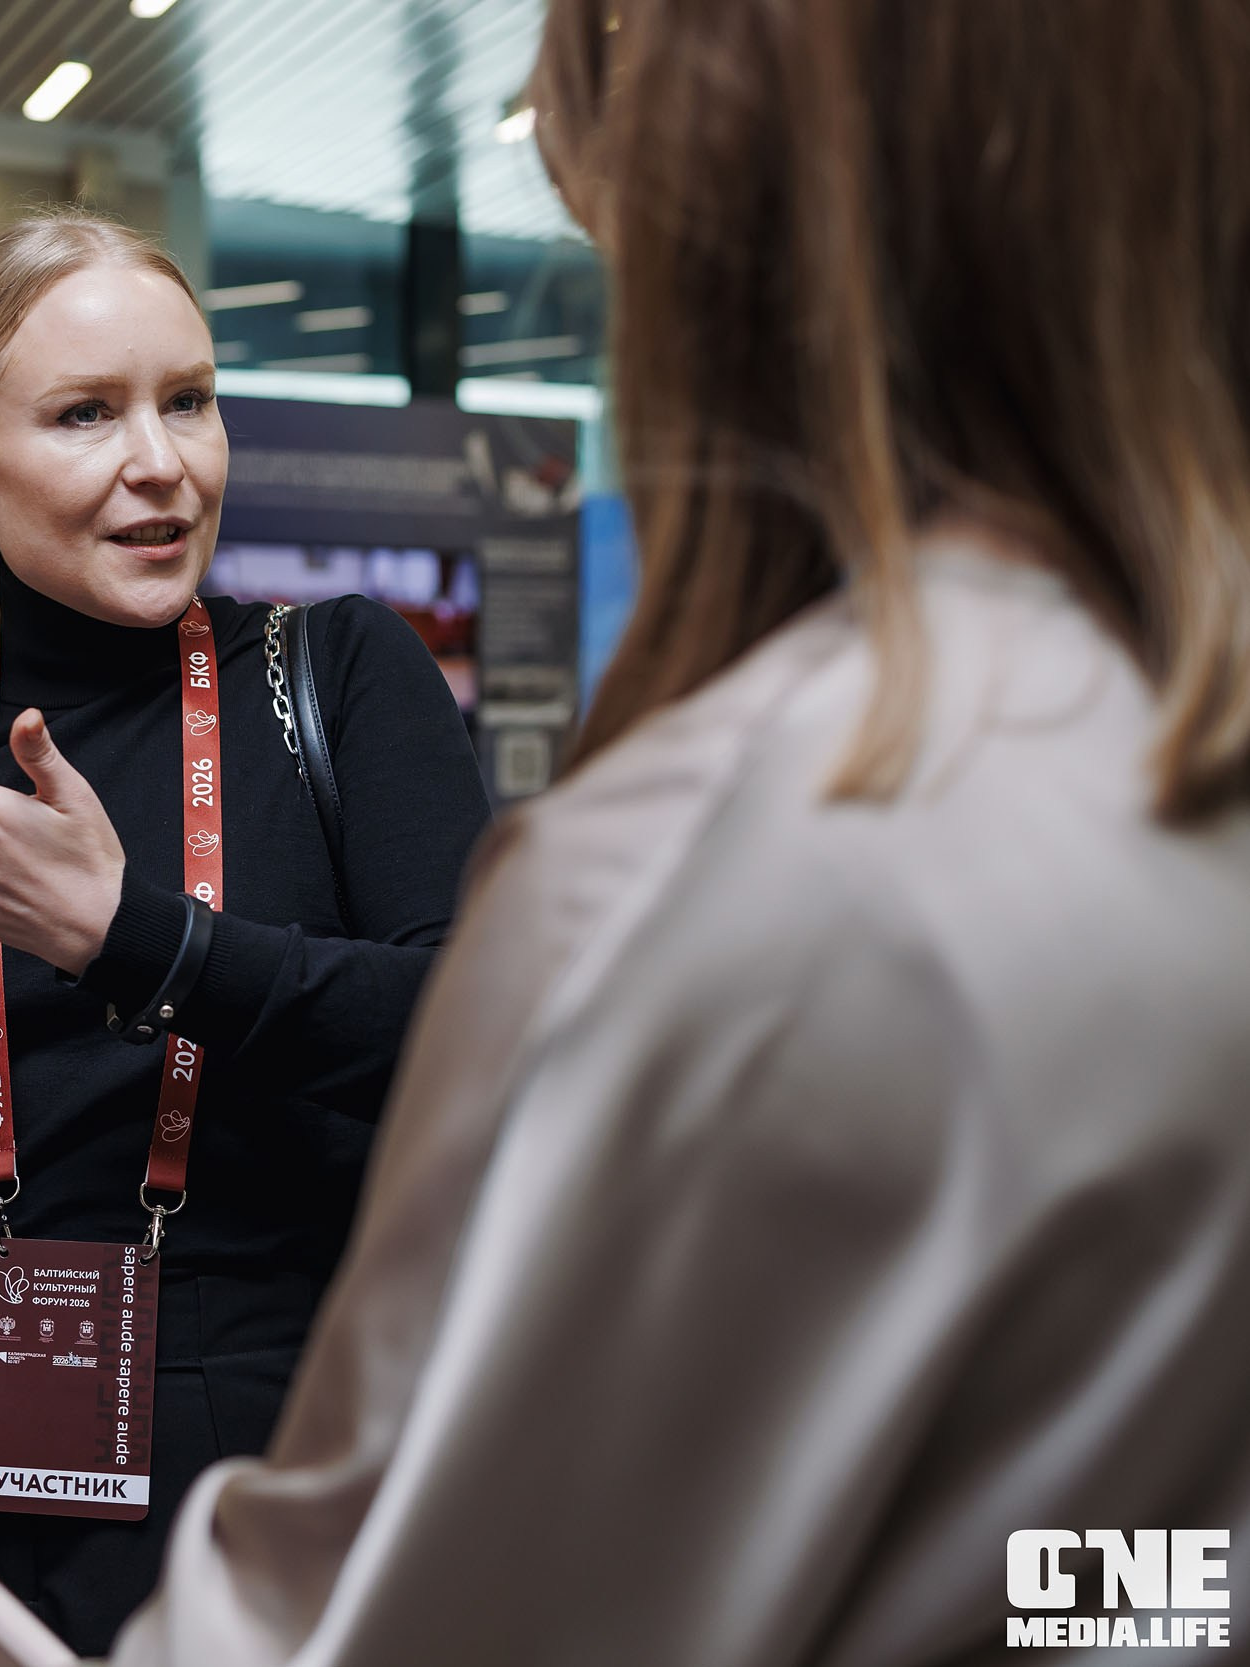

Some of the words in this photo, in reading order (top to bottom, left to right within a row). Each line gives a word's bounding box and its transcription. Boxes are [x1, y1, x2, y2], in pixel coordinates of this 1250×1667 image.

[189, 651, 210, 689] БКФ
[191, 758, 214, 807] 2026
[172, 1037, 197, 1082] 202
[33, 1268, 100, 1280] БАЛТИЙСКИЙ
[33, 1282, 97, 1294] КУЛЬТУРНЫЙ
[121, 1247, 136, 1304] sapere
[32, 1296, 68, 1307] ФОРУМ
[69, 1298, 90, 1308] 2026
[120, 1309, 135, 1353] aude
[116, 1358, 131, 1416] sapere
[116, 1421, 131, 1465] aude
